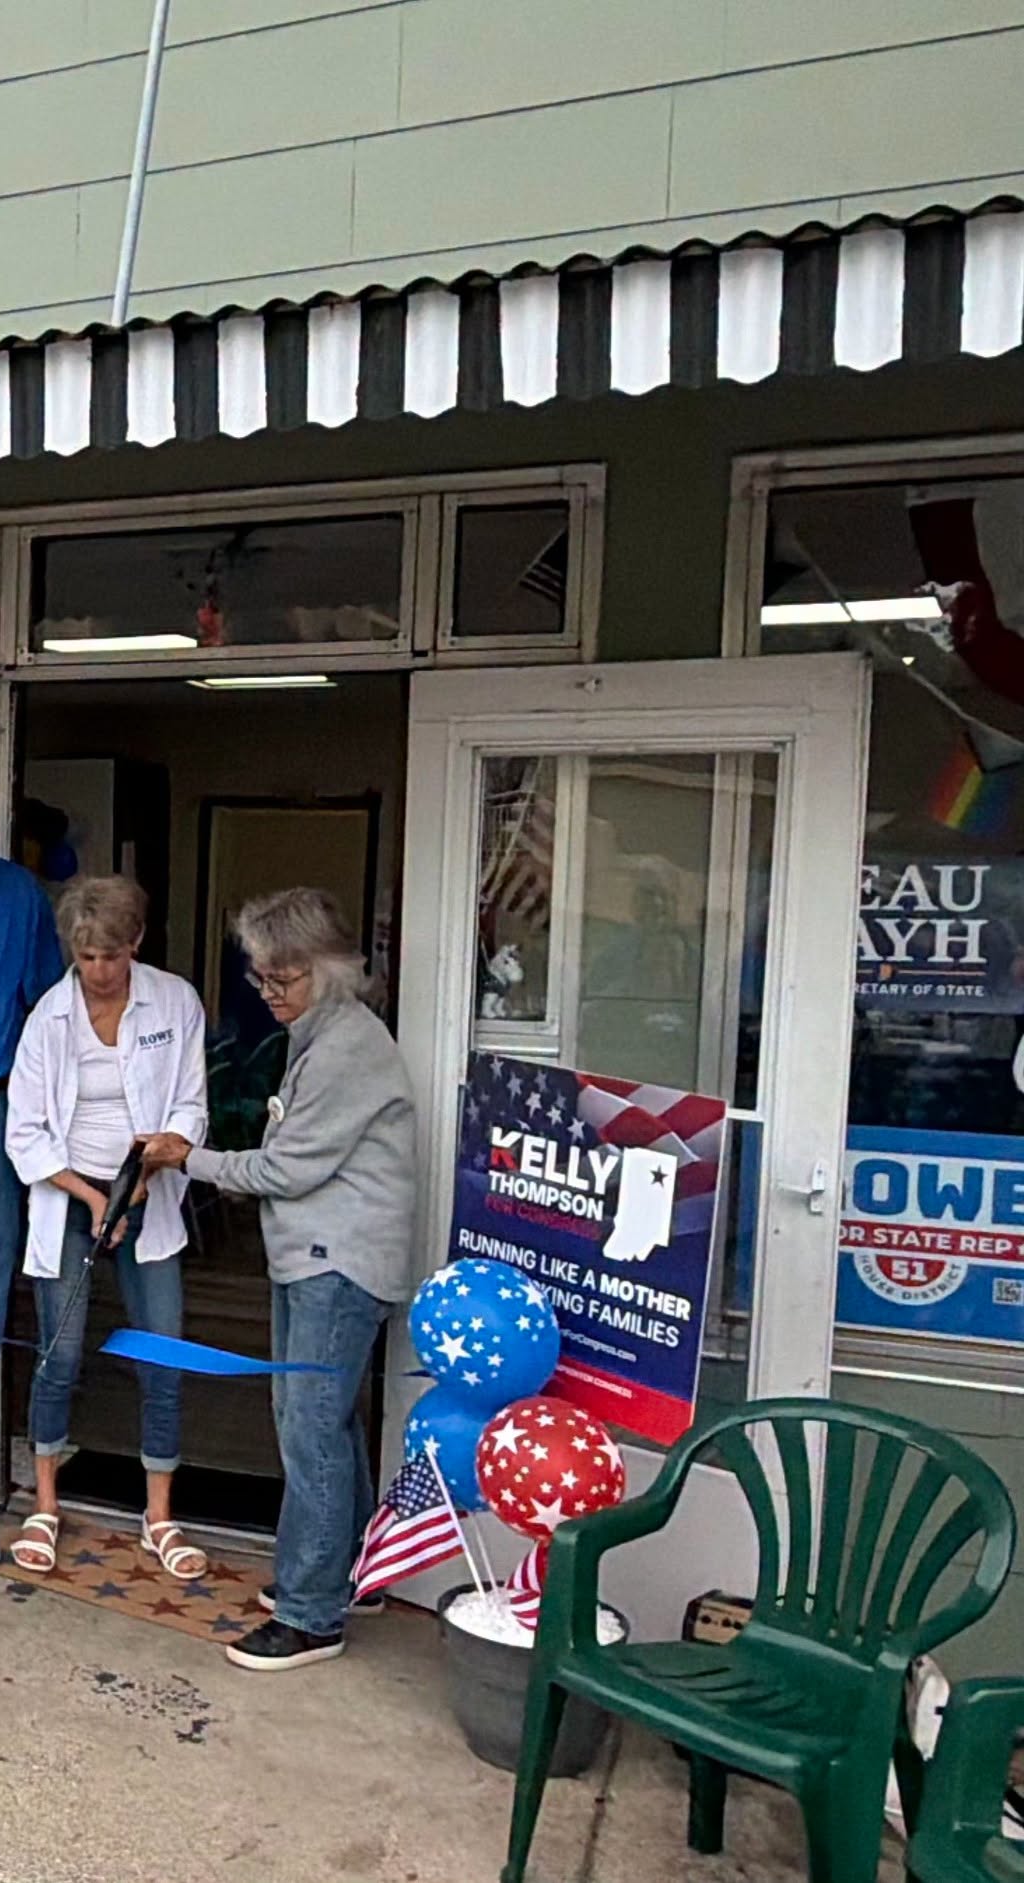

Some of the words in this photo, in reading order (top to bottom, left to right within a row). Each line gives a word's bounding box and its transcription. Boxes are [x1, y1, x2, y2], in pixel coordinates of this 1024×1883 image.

[860, 864, 992, 912] EAU
[857, 917, 990, 963] AYH
[913, 984, 933, 995] OF
[935, 985, 985, 996] STATE
[490, 1126, 619, 1195] KELLY
[488, 1170, 604, 1221] THOMPSON
[842, 1158, 1024, 1226] OWE
[838, 1225, 865, 1242] OR
[873, 1228, 952, 1250] STATE
[960, 1235, 1013, 1255] REP
[458, 1228, 536, 1269] RUNNING
[540, 1255, 580, 1284] LIKE
[582, 1269, 597, 1290] A
[600, 1273, 692, 1321] MOTHER
[860, 1254, 895, 1295] HOUSE
[902, 1263, 962, 1300] DISTRICT
[891, 1259, 929, 1282] 51
[588, 1299, 680, 1348] FAMILIES
